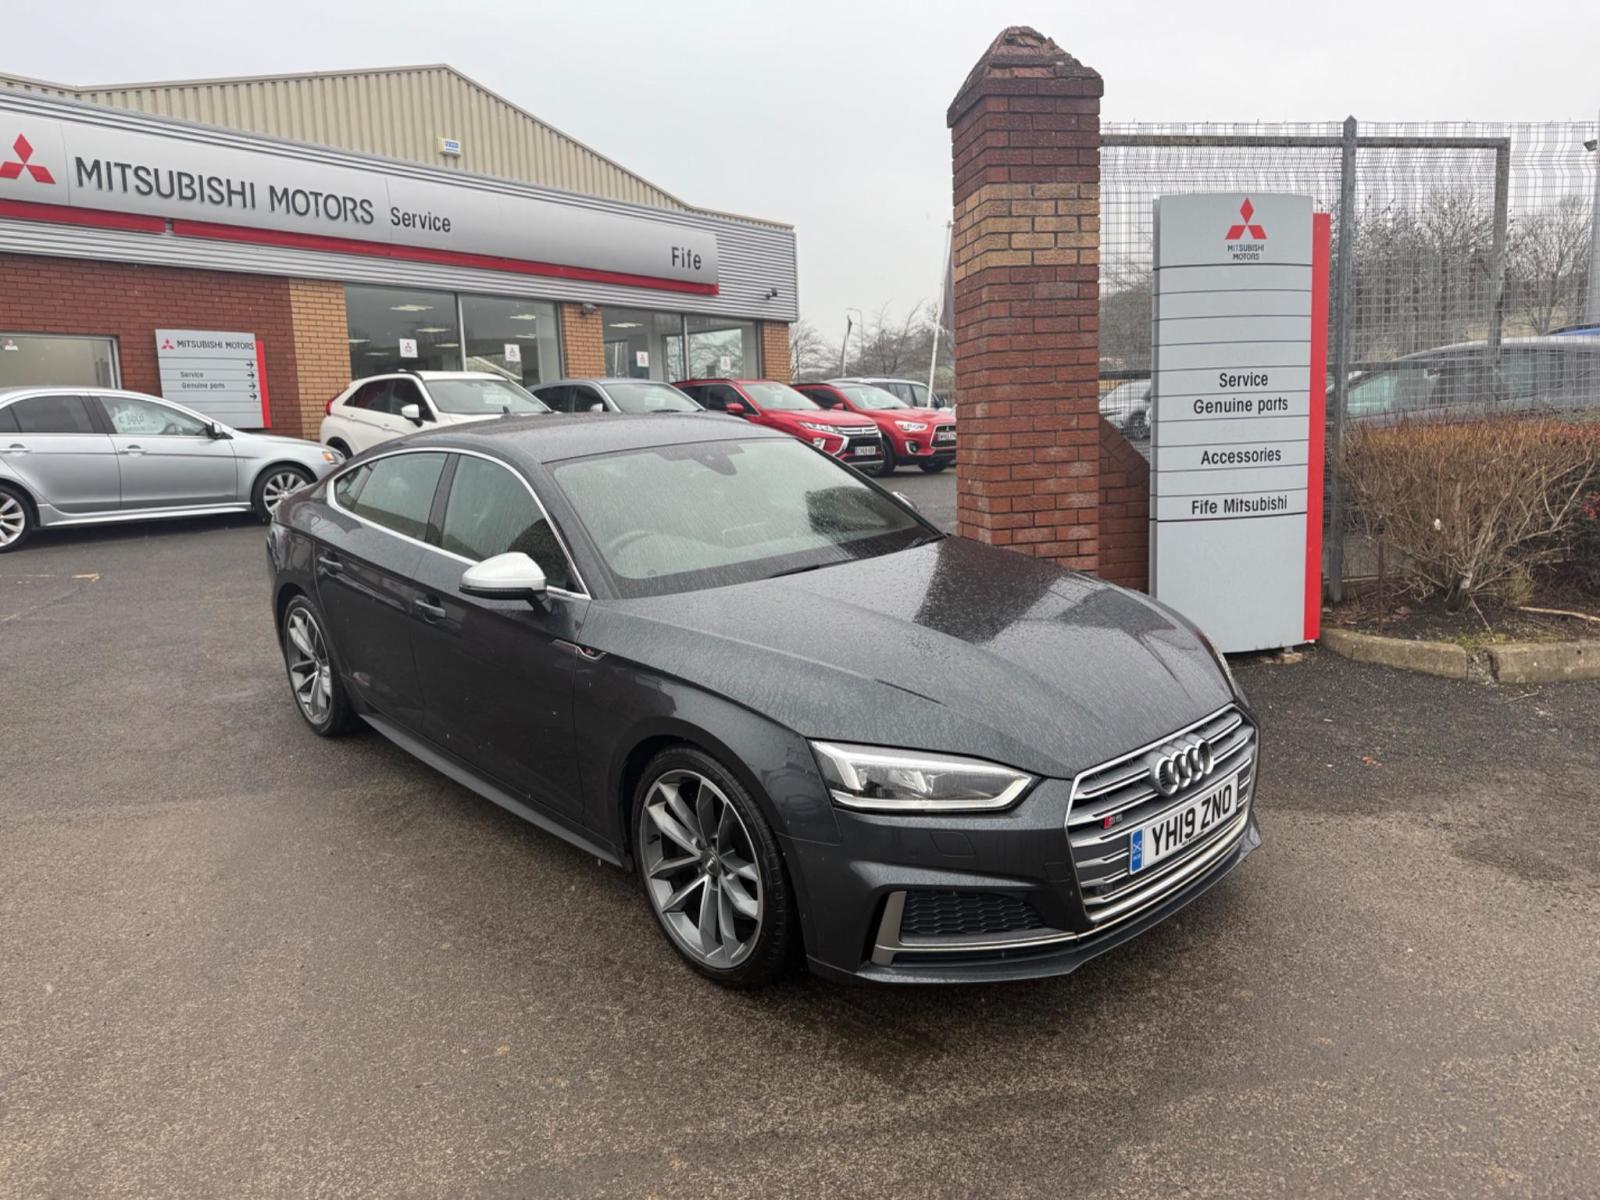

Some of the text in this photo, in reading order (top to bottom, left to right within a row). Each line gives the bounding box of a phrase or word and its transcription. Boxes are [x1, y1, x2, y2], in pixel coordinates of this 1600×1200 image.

[75, 156, 701, 269] MITSUBISHI MOTORS Service Fife
[1227, 244, 1264, 252] MITSUBISHI
[177, 340, 254, 350] MITSUBISHI MOTORS
[1219, 372, 1269, 387] Service
[1193, 396, 1288, 414] Genuine parts
[1201, 448, 1281, 465] Accessories
[1192, 495, 1287, 515] Fife Mitsubishi
[1152, 784, 1232, 855] YH19 ZNO
